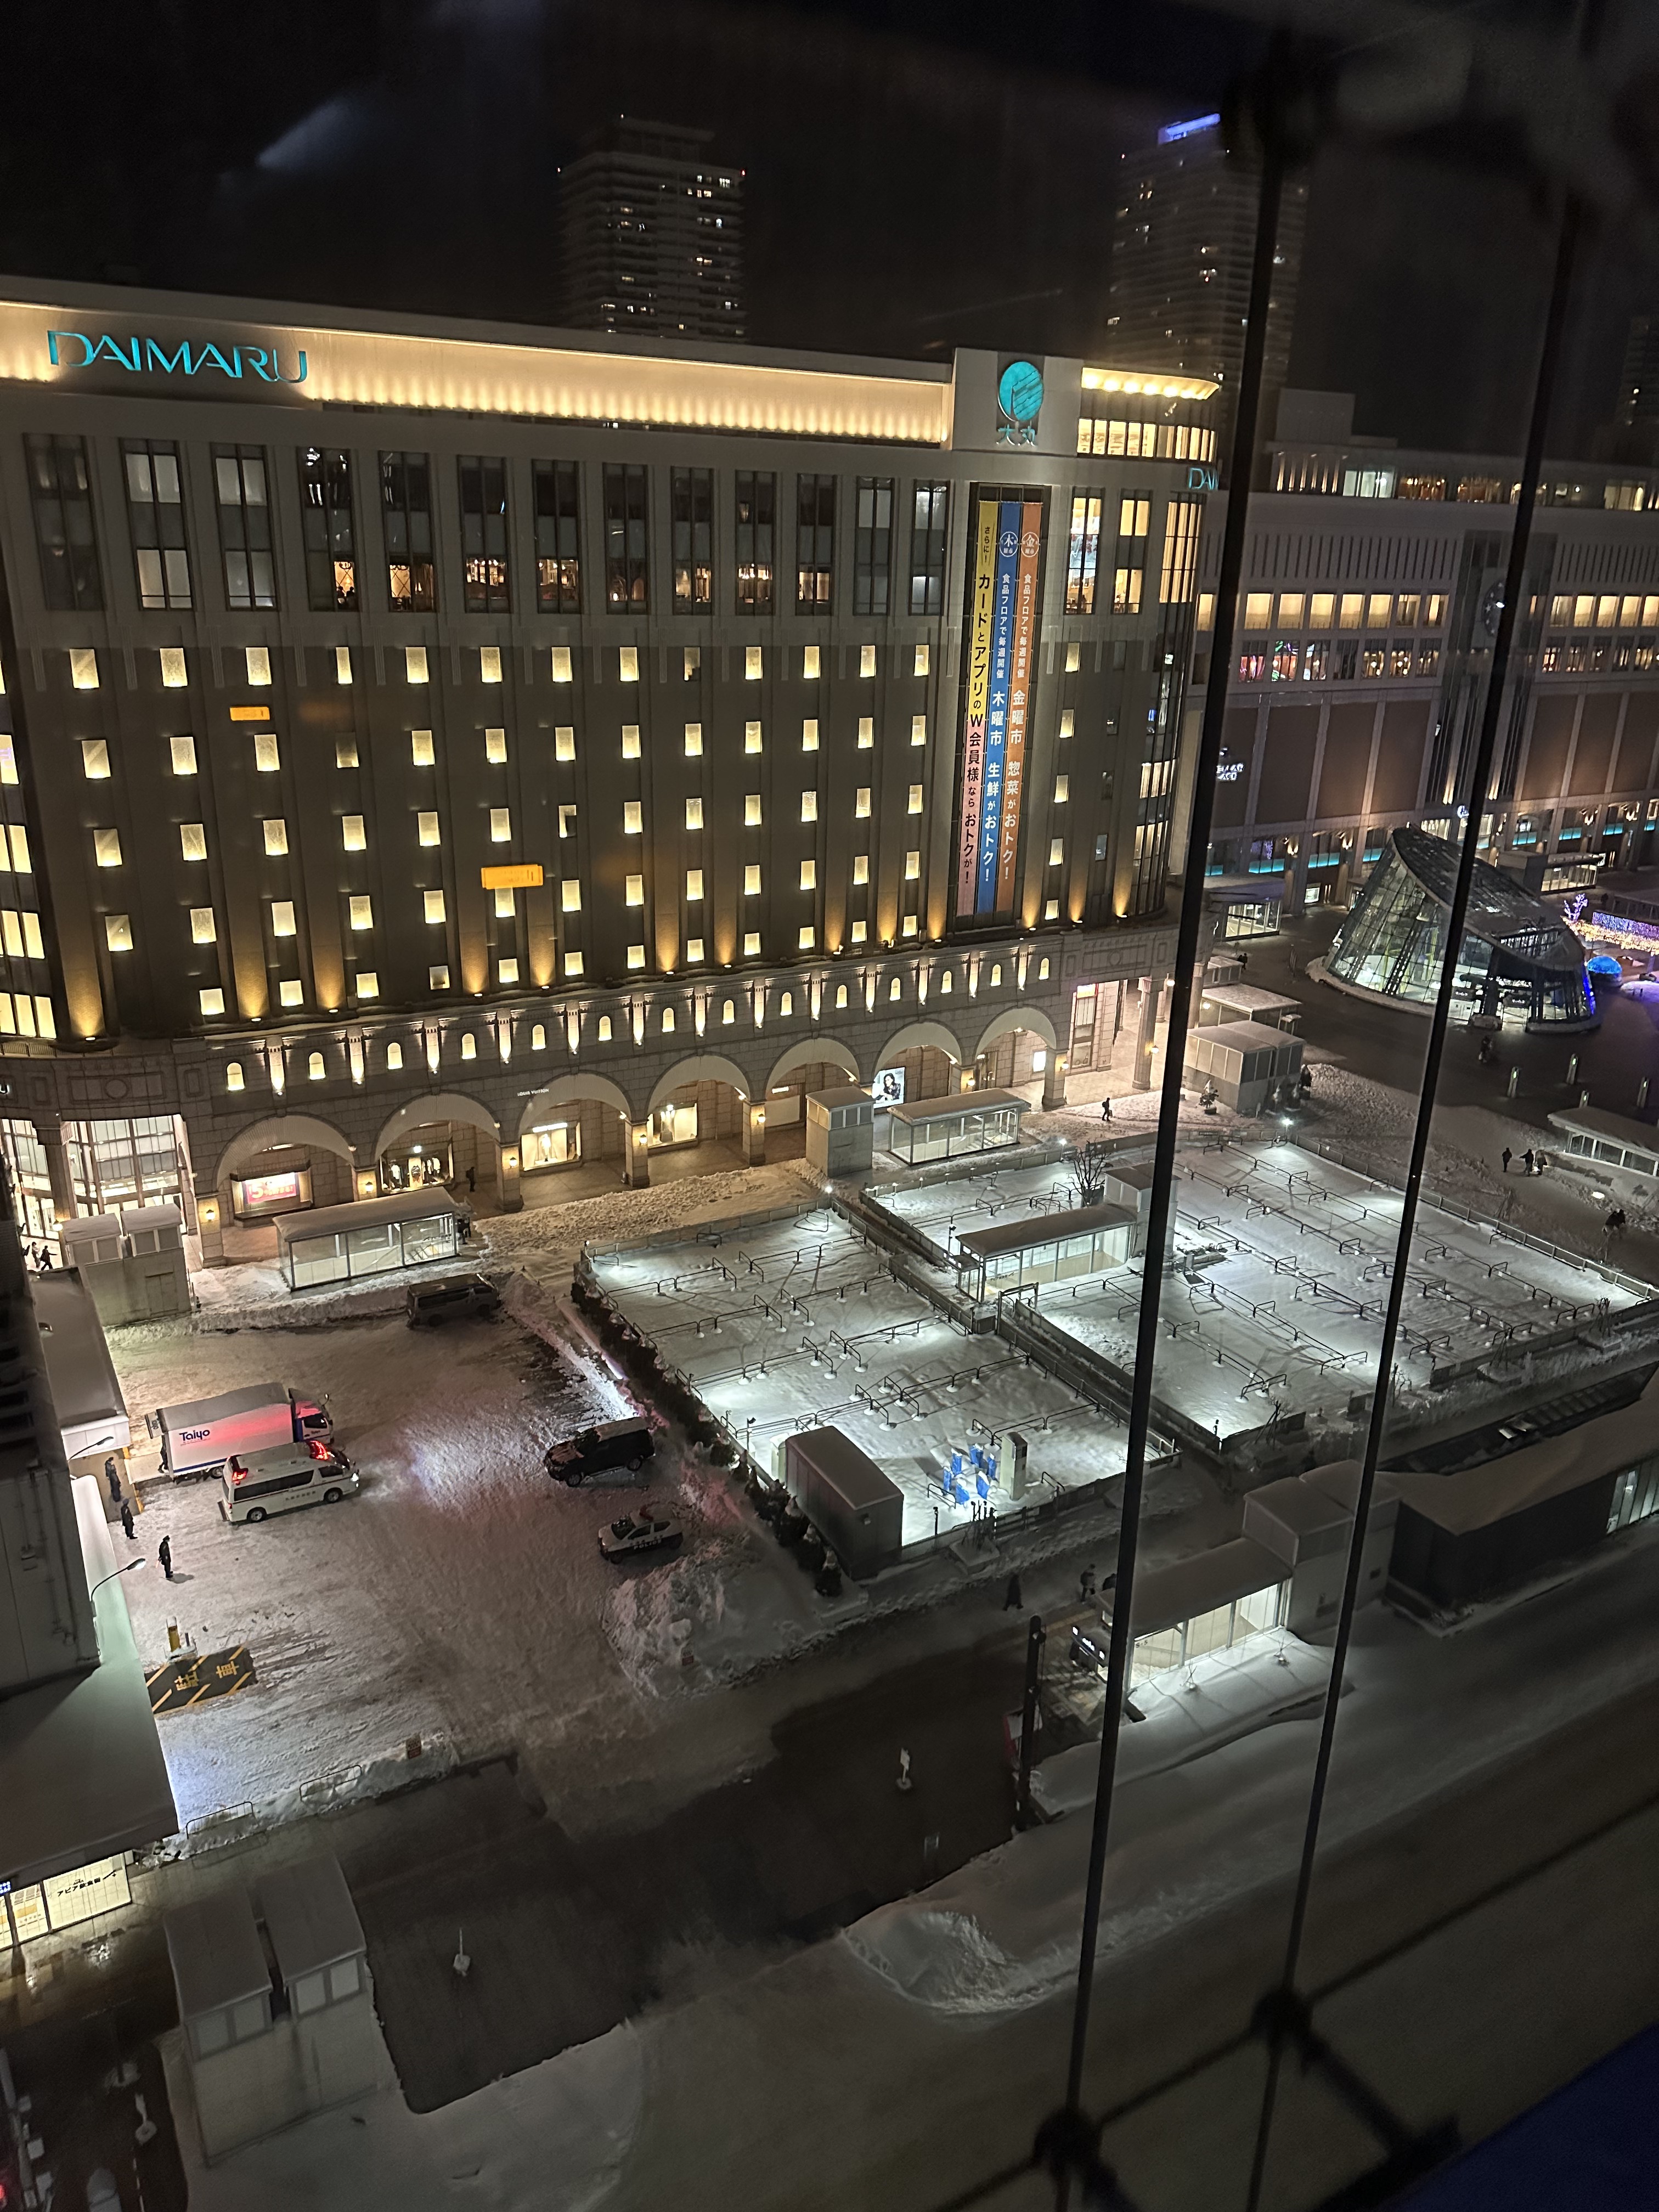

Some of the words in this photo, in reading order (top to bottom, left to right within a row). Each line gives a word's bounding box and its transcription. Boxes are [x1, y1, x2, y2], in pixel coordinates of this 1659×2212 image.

[47, 330, 307, 383] DAIMARU
[996, 424, 1038, 446] 大丸
[996, 573, 1011, 679] 食品フロアで毎週開催
[1017, 573, 1032, 679] 食品フロアで毎週開催
[990, 691, 1006, 746] 木曜市
[1011, 690, 1026, 744] 金曜市
[179, 1430, 210, 1441] Taiyo
